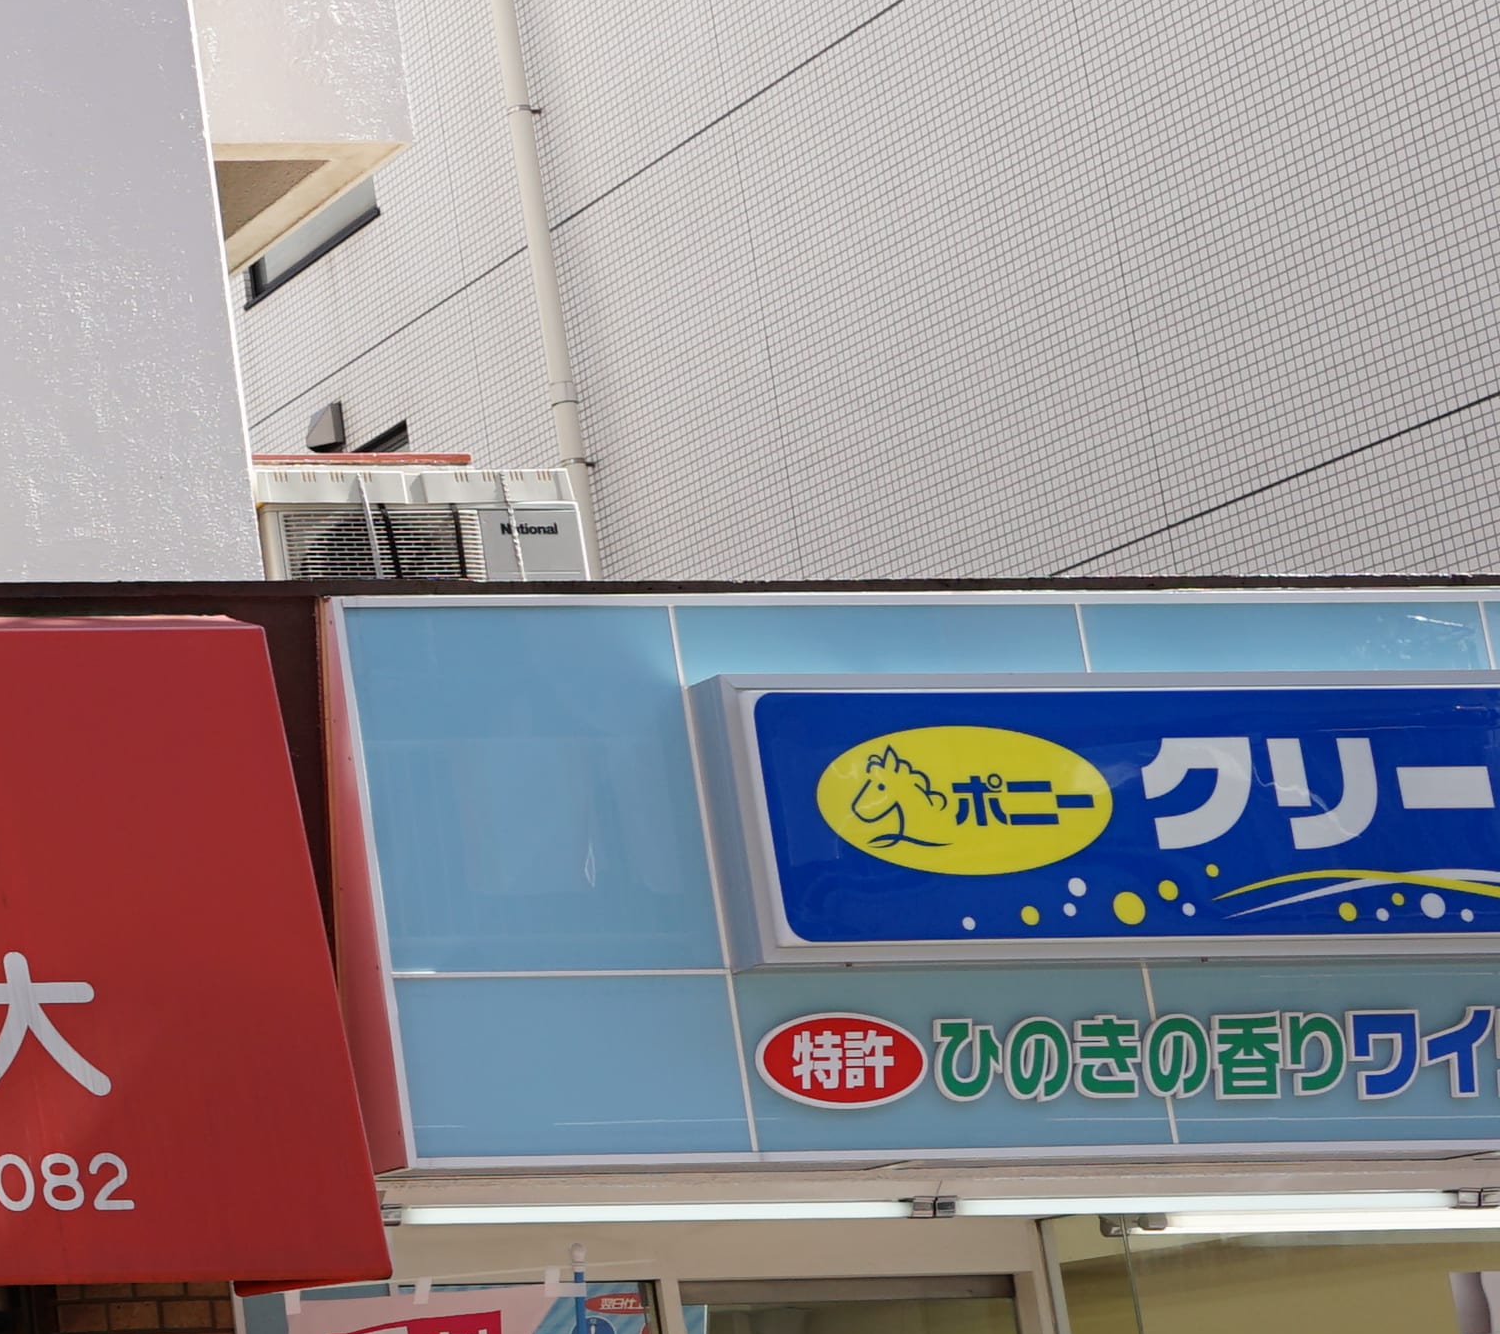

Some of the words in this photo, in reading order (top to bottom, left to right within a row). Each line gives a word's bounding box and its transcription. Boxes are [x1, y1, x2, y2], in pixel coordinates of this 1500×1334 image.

[500, 522, 558, 535] Ntional
[952, 773, 1095, 827] ポニー
[1141, 738, 1495, 850] クリー
[791, 1030, 895, 1090] 特許
